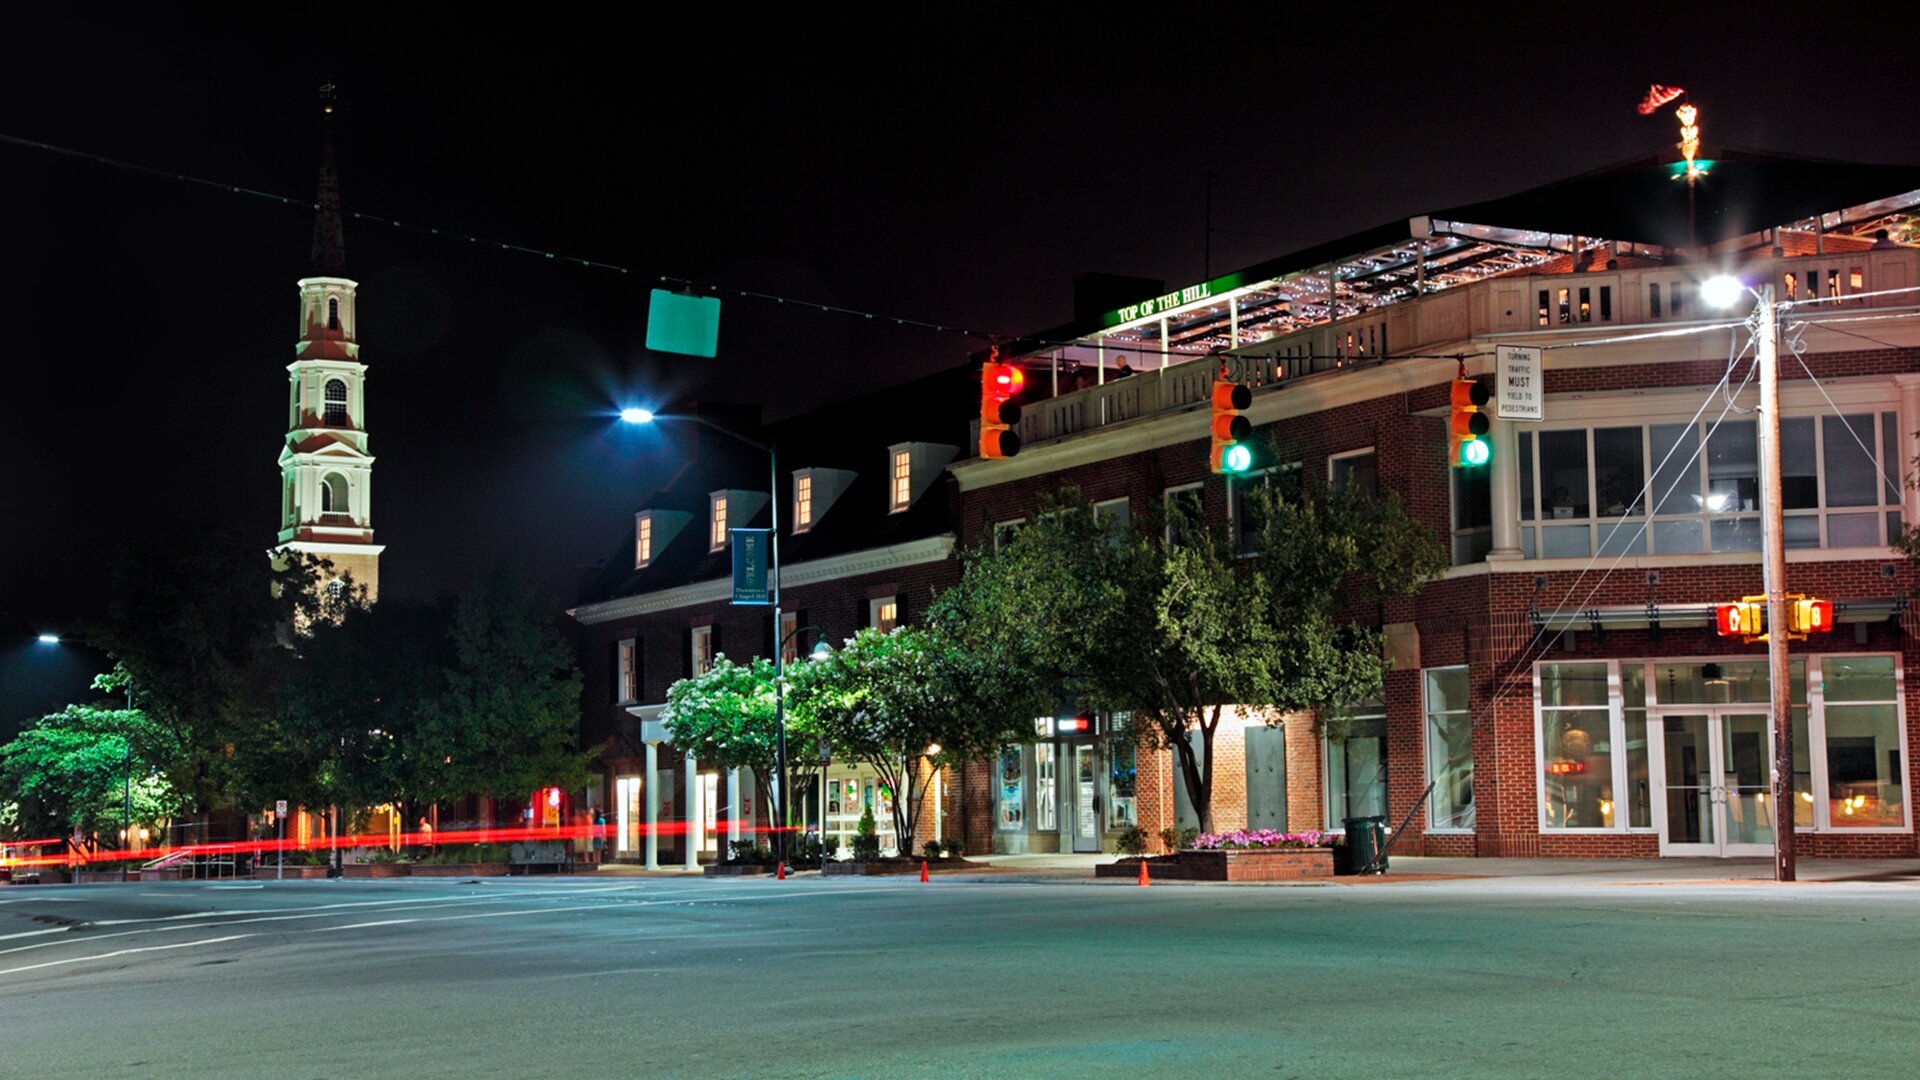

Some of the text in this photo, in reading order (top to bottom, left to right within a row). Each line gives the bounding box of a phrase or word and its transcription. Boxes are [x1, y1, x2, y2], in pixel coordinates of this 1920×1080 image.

[1118, 282, 1211, 323] TOP OF THE HILL
[1507, 352, 1531, 361] TURNING
[1508, 365, 1530, 374] TRAFFIC
[1508, 376, 1530, 387] MUST
[1507, 392, 1532, 401] YIELD TO
[1501, 404, 1538, 413] PEDESTRIANS
